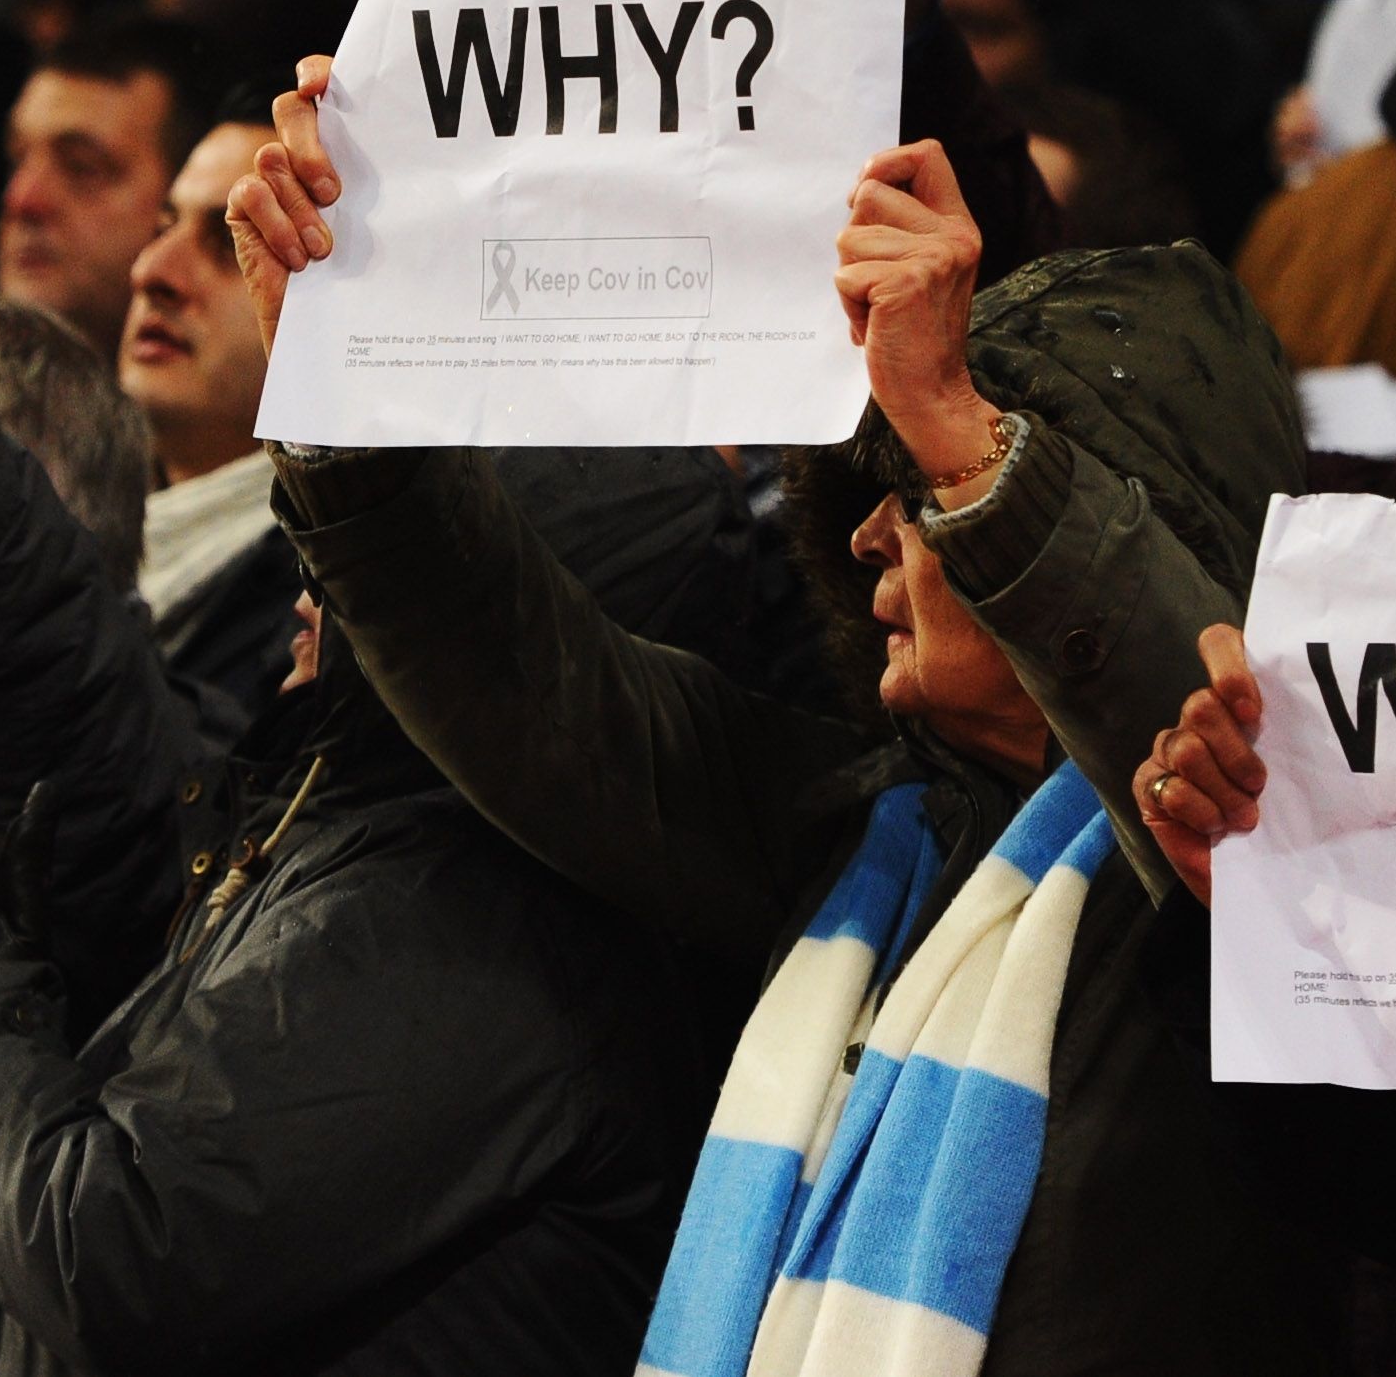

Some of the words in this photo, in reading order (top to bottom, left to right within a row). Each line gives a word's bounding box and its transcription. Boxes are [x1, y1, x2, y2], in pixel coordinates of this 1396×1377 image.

[525, 268, 580, 298] Keep
[588, 267, 631, 291] Cov
[637, 266, 656, 290] in
[665, 266, 709, 290] Cov
[349, 335, 373, 344] Please
[506, 334, 528, 343] WANT
[531, 334, 541, 343] TO
[542, 334, 555, 343] GO
[588, 333, 611, 342] WANT
[613, 333, 623, 342] TO
[624, 333, 636, 342] GO
[664, 332, 685, 342] BACK
[689, 332, 699, 342] TO
[701, 332, 717, 342] THE
[748, 332, 763, 342] THE
[1294, 971, 1327, 980] Please
[1375, 974, 1387, 982] on
[1295, 995, 1311, 1006] (35
[1314, 996, 1350, 1006] minutes
